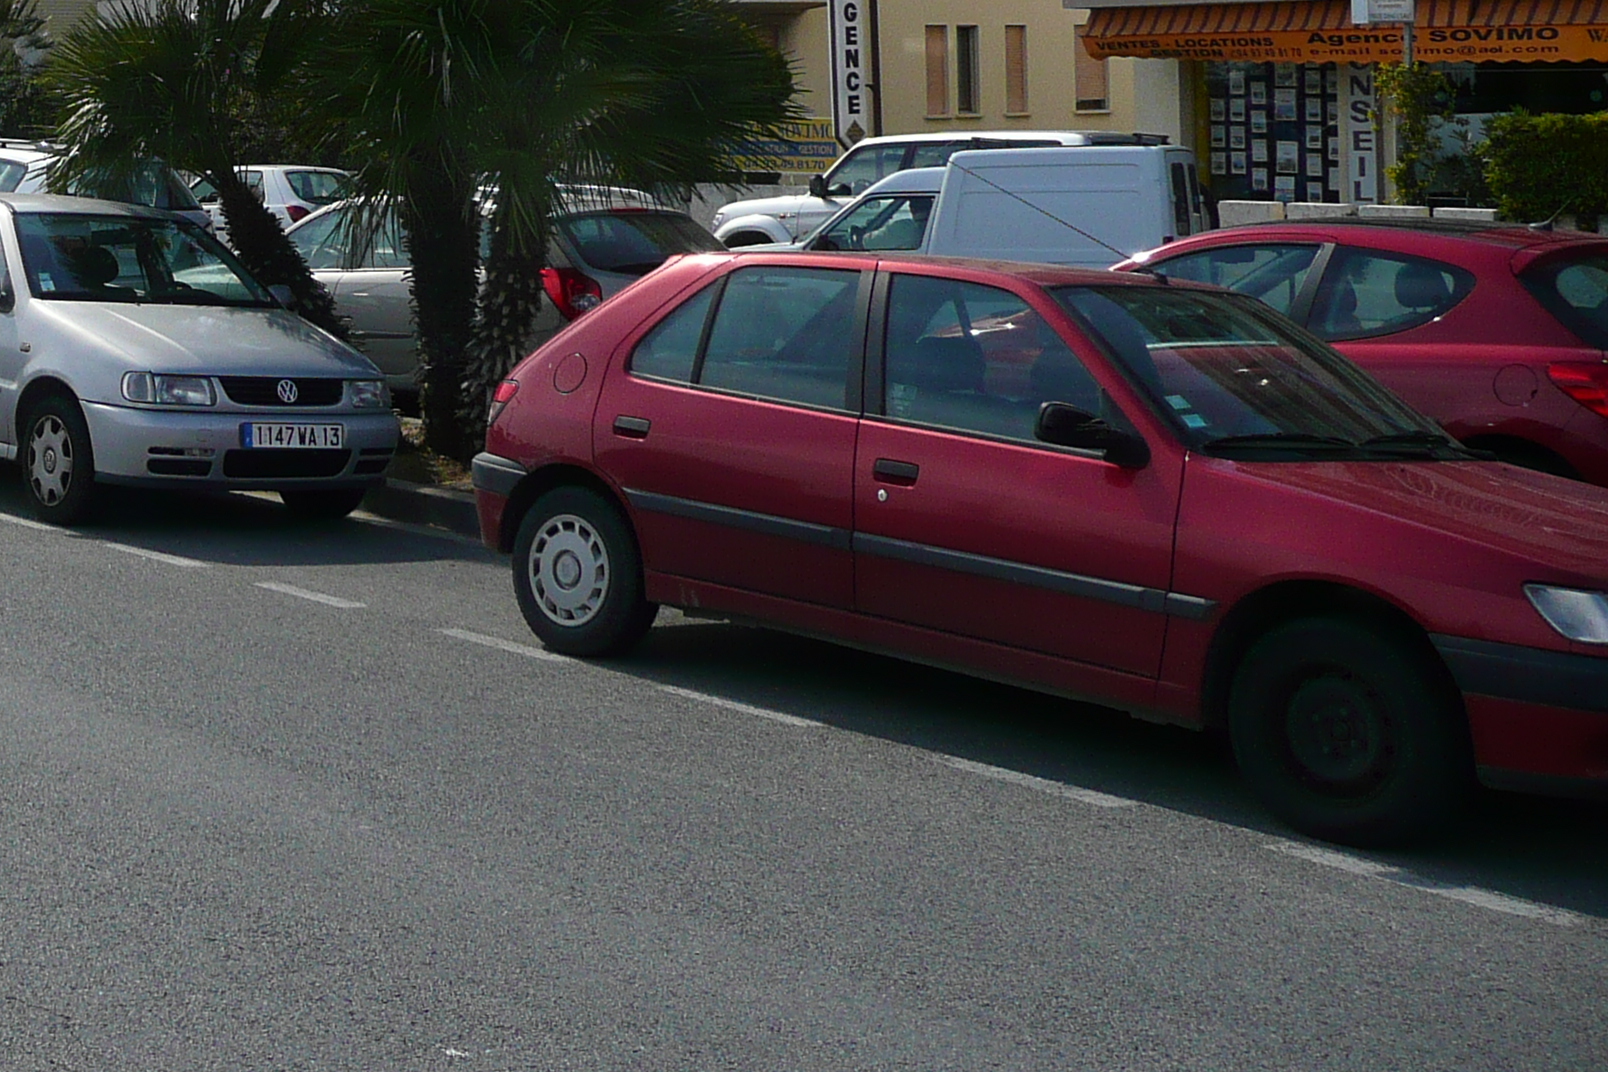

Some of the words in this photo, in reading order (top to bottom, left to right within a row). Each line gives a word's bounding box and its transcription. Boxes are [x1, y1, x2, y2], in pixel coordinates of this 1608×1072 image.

[1429, 27, 1559, 42] SOVIMO
[1096, 38, 1161, 50] VENTES
[1175, 37, 1274, 49] LOCATIONS
[1150, 48, 1224, 57] GESTION
[1309, 47, 1371, 56] e-mail
[1379, 45, 1560, 56] soimo@aol.com
[781, 123, 834, 138] OVIMO
[798, 145, 834, 155] GESTION
[257, 426, 295, 446] 1147
[297, 426, 317, 446] WA
[323, 427, 340, 446] 13
